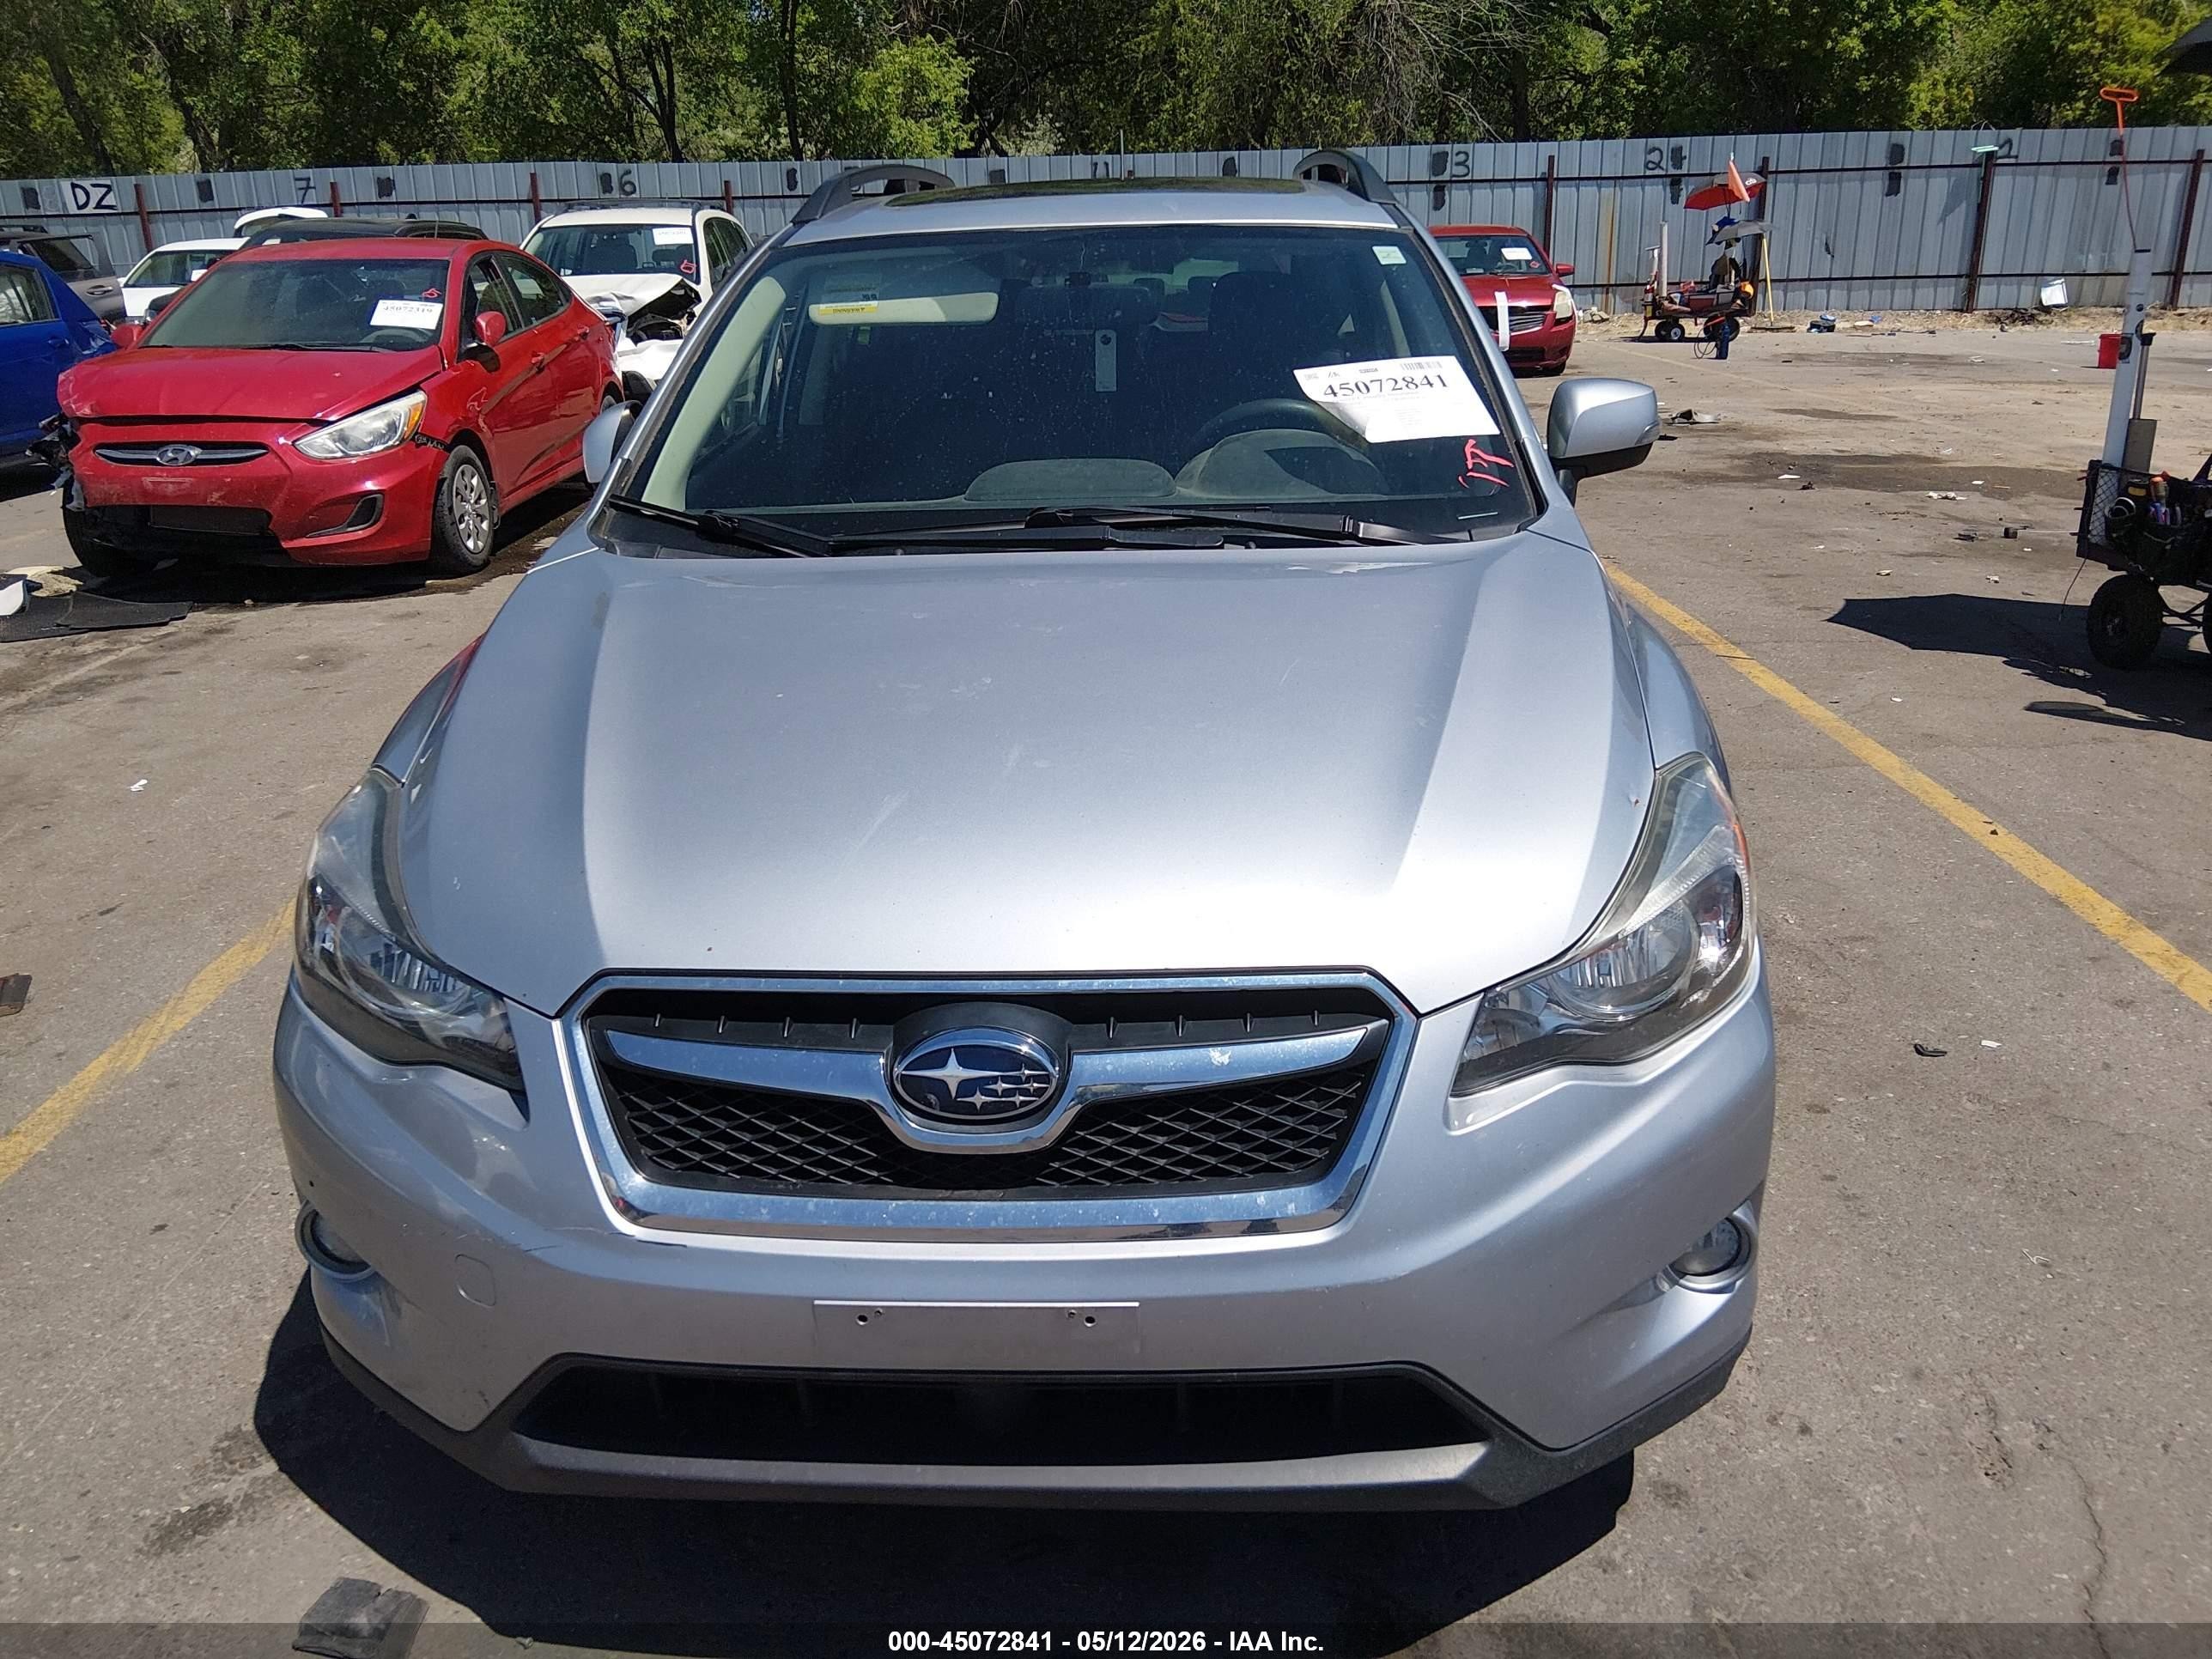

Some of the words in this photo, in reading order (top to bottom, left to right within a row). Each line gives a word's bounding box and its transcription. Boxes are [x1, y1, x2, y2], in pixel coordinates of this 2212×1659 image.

[1451, 150, 1471, 178] 3
[1644, 147, 1664, 171] 2
[70, 182, 117, 210] DZ
[295, 177, 316, 204] 7
[618, 170, 637, 196] 6
[1323, 374, 1449, 398] 45072841
